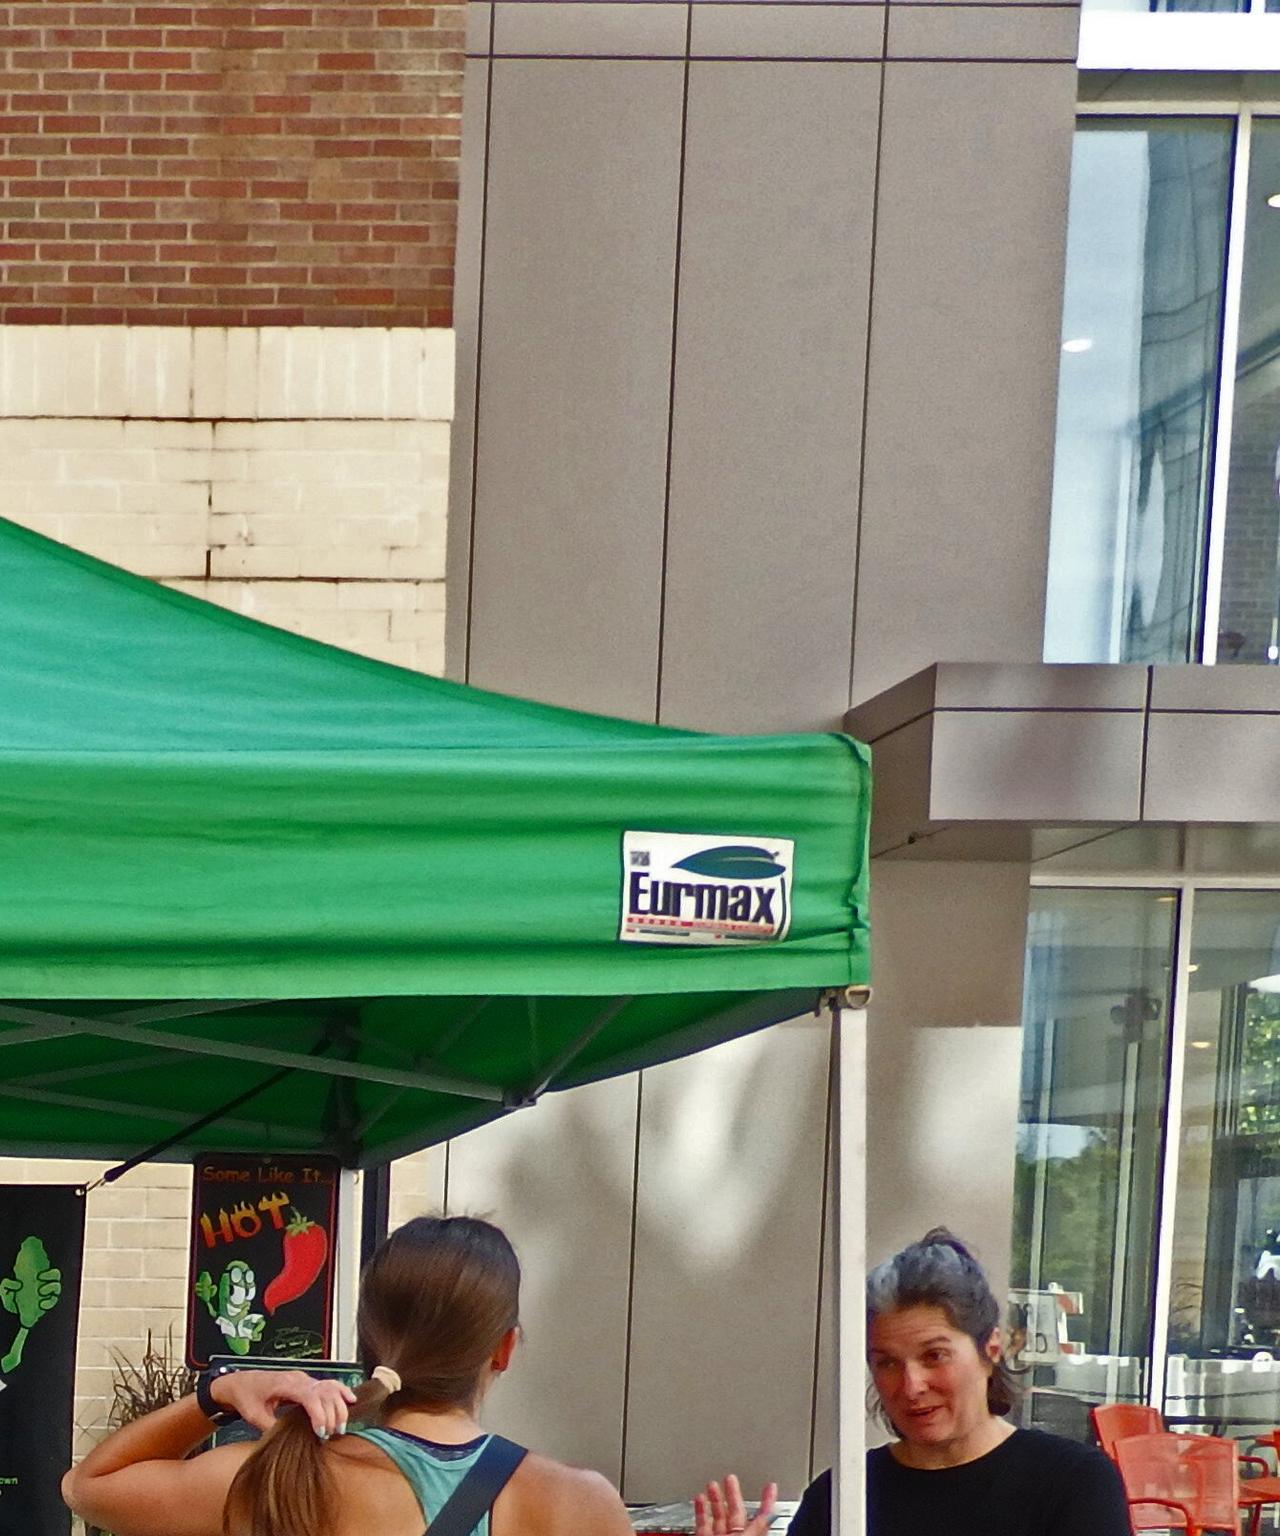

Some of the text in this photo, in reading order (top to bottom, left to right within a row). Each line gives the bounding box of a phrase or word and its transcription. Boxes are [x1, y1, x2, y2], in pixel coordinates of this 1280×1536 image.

[629, 871, 776, 924] Eurmax
[203, 1166, 250, 1182] Some
[258, 1166, 294, 1182] Like
[200, 1191, 290, 1249] HOT
